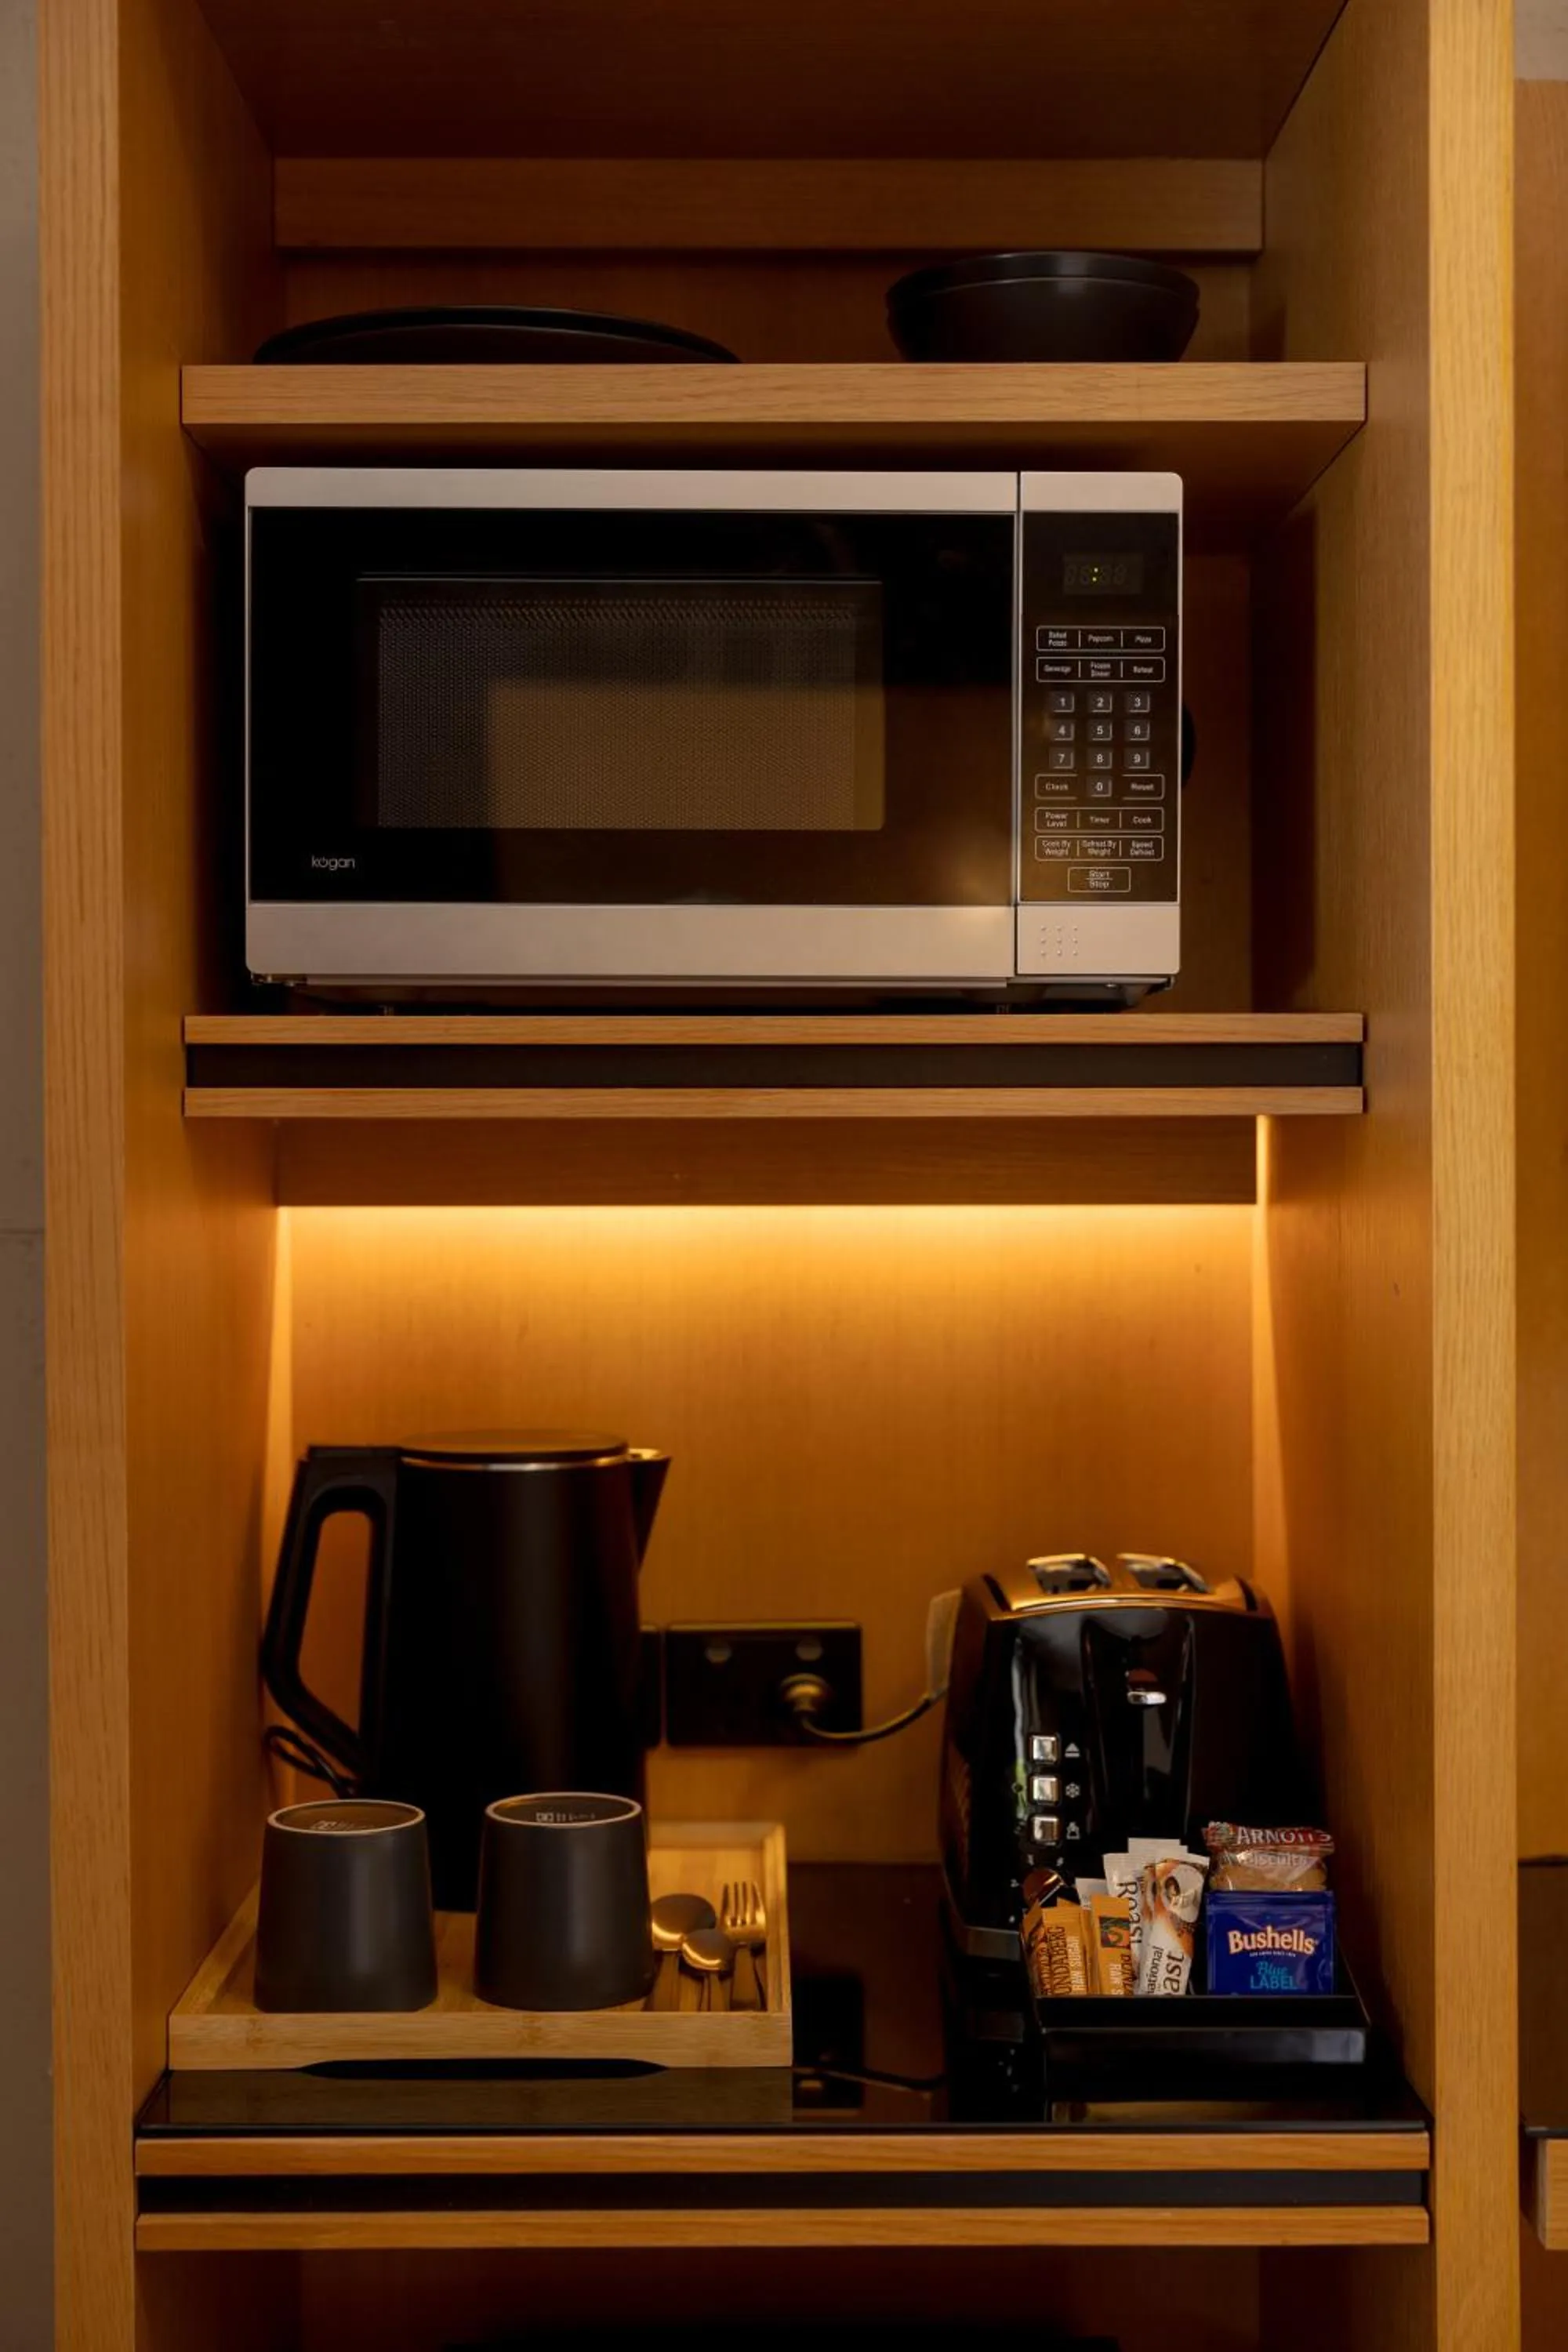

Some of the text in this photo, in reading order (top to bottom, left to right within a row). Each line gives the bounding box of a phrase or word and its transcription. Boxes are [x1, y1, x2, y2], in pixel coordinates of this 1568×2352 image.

[1059, 697, 1066, 707] 1
[1097, 697, 1104, 707] 2
[1134, 697, 1142, 707] 3
[1058, 725, 1065, 735] 4
[1097, 725, 1104, 735] 5
[1134, 725, 1142, 735] 6
[1058, 753, 1065, 764] 7
[1097, 753, 1104, 764] 8
[1134, 753, 1142, 764] 9
[1097, 782, 1104, 792] 0
[311, 855, 355, 871] kogan
[1089, 869, 1109, 878] Start
[1089, 880, 1109, 888] Stop
[1228, 1926, 1316, 1955] Bushells
[1047, 1926, 1072, 1995] UNDABERG
[1147, 1945, 1164, 1994] ational
[1163, 1951, 1185, 1995] ast
[1256, 1961, 1288, 1976] Blue
[1250, 1975, 1298, 1990] LABEL
